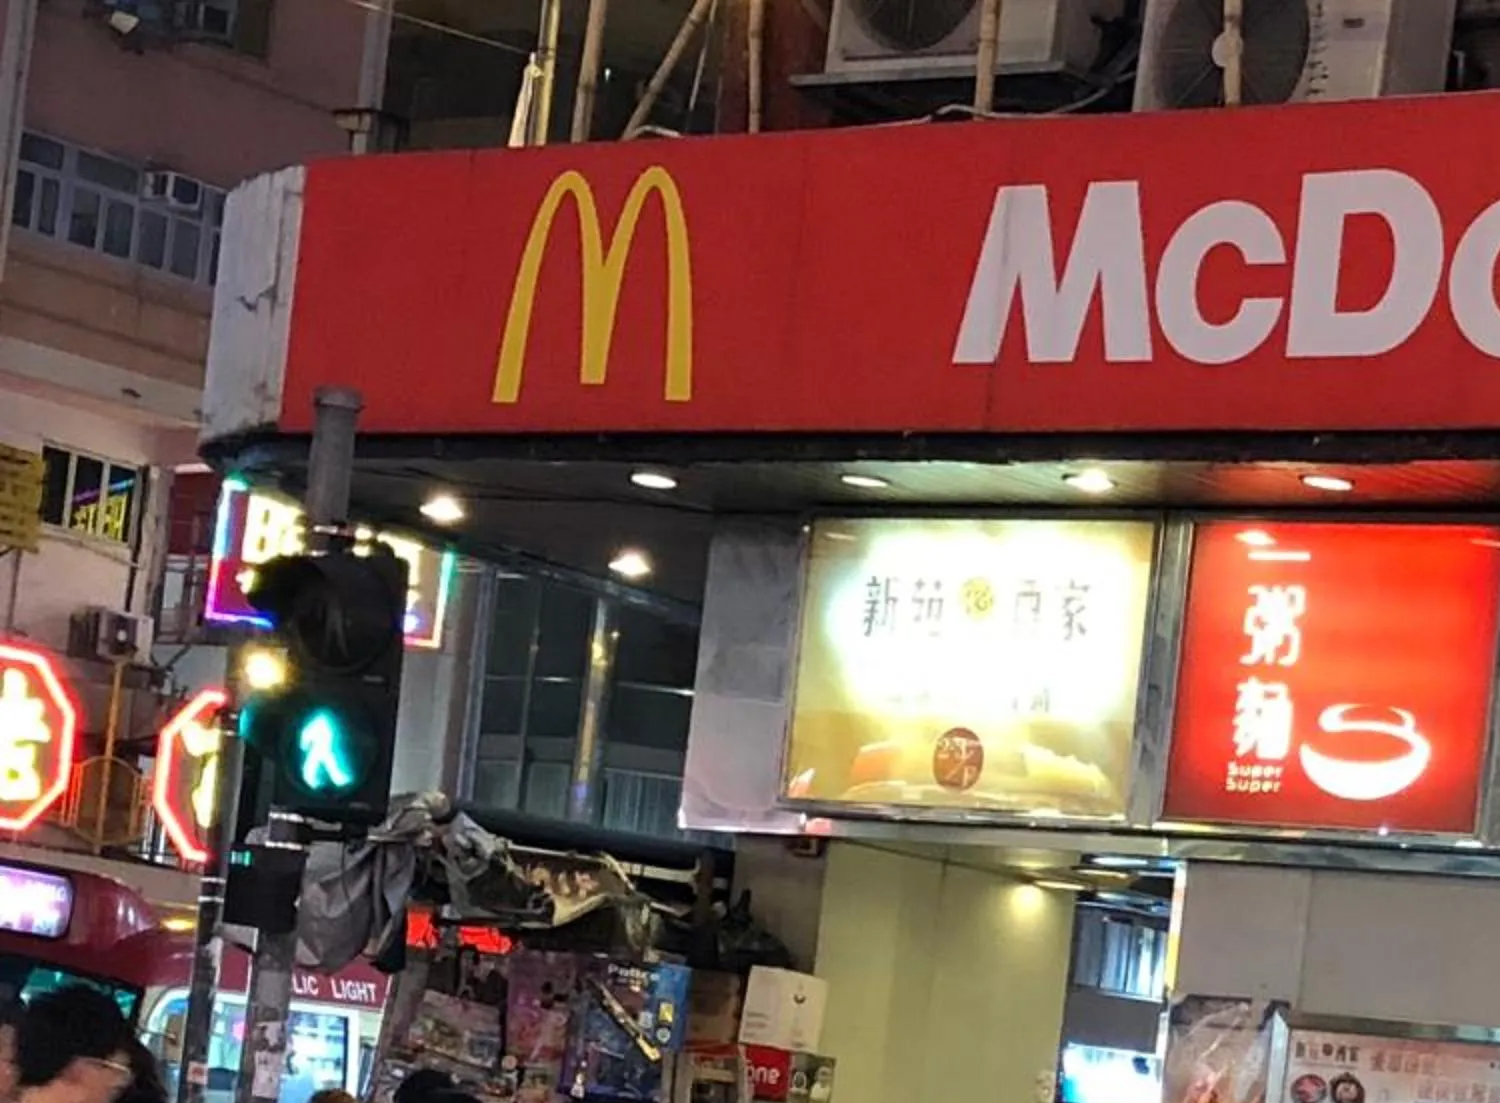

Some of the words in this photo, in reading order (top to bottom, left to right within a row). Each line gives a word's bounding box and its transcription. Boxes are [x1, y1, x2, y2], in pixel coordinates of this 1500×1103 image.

[491, 166, 693, 404] M
[1228, 761, 1284, 779] Super
[1226, 777, 1281, 793] Super
[291, 975, 320, 996] LIC
[331, 978, 377, 1003] LIGHT
